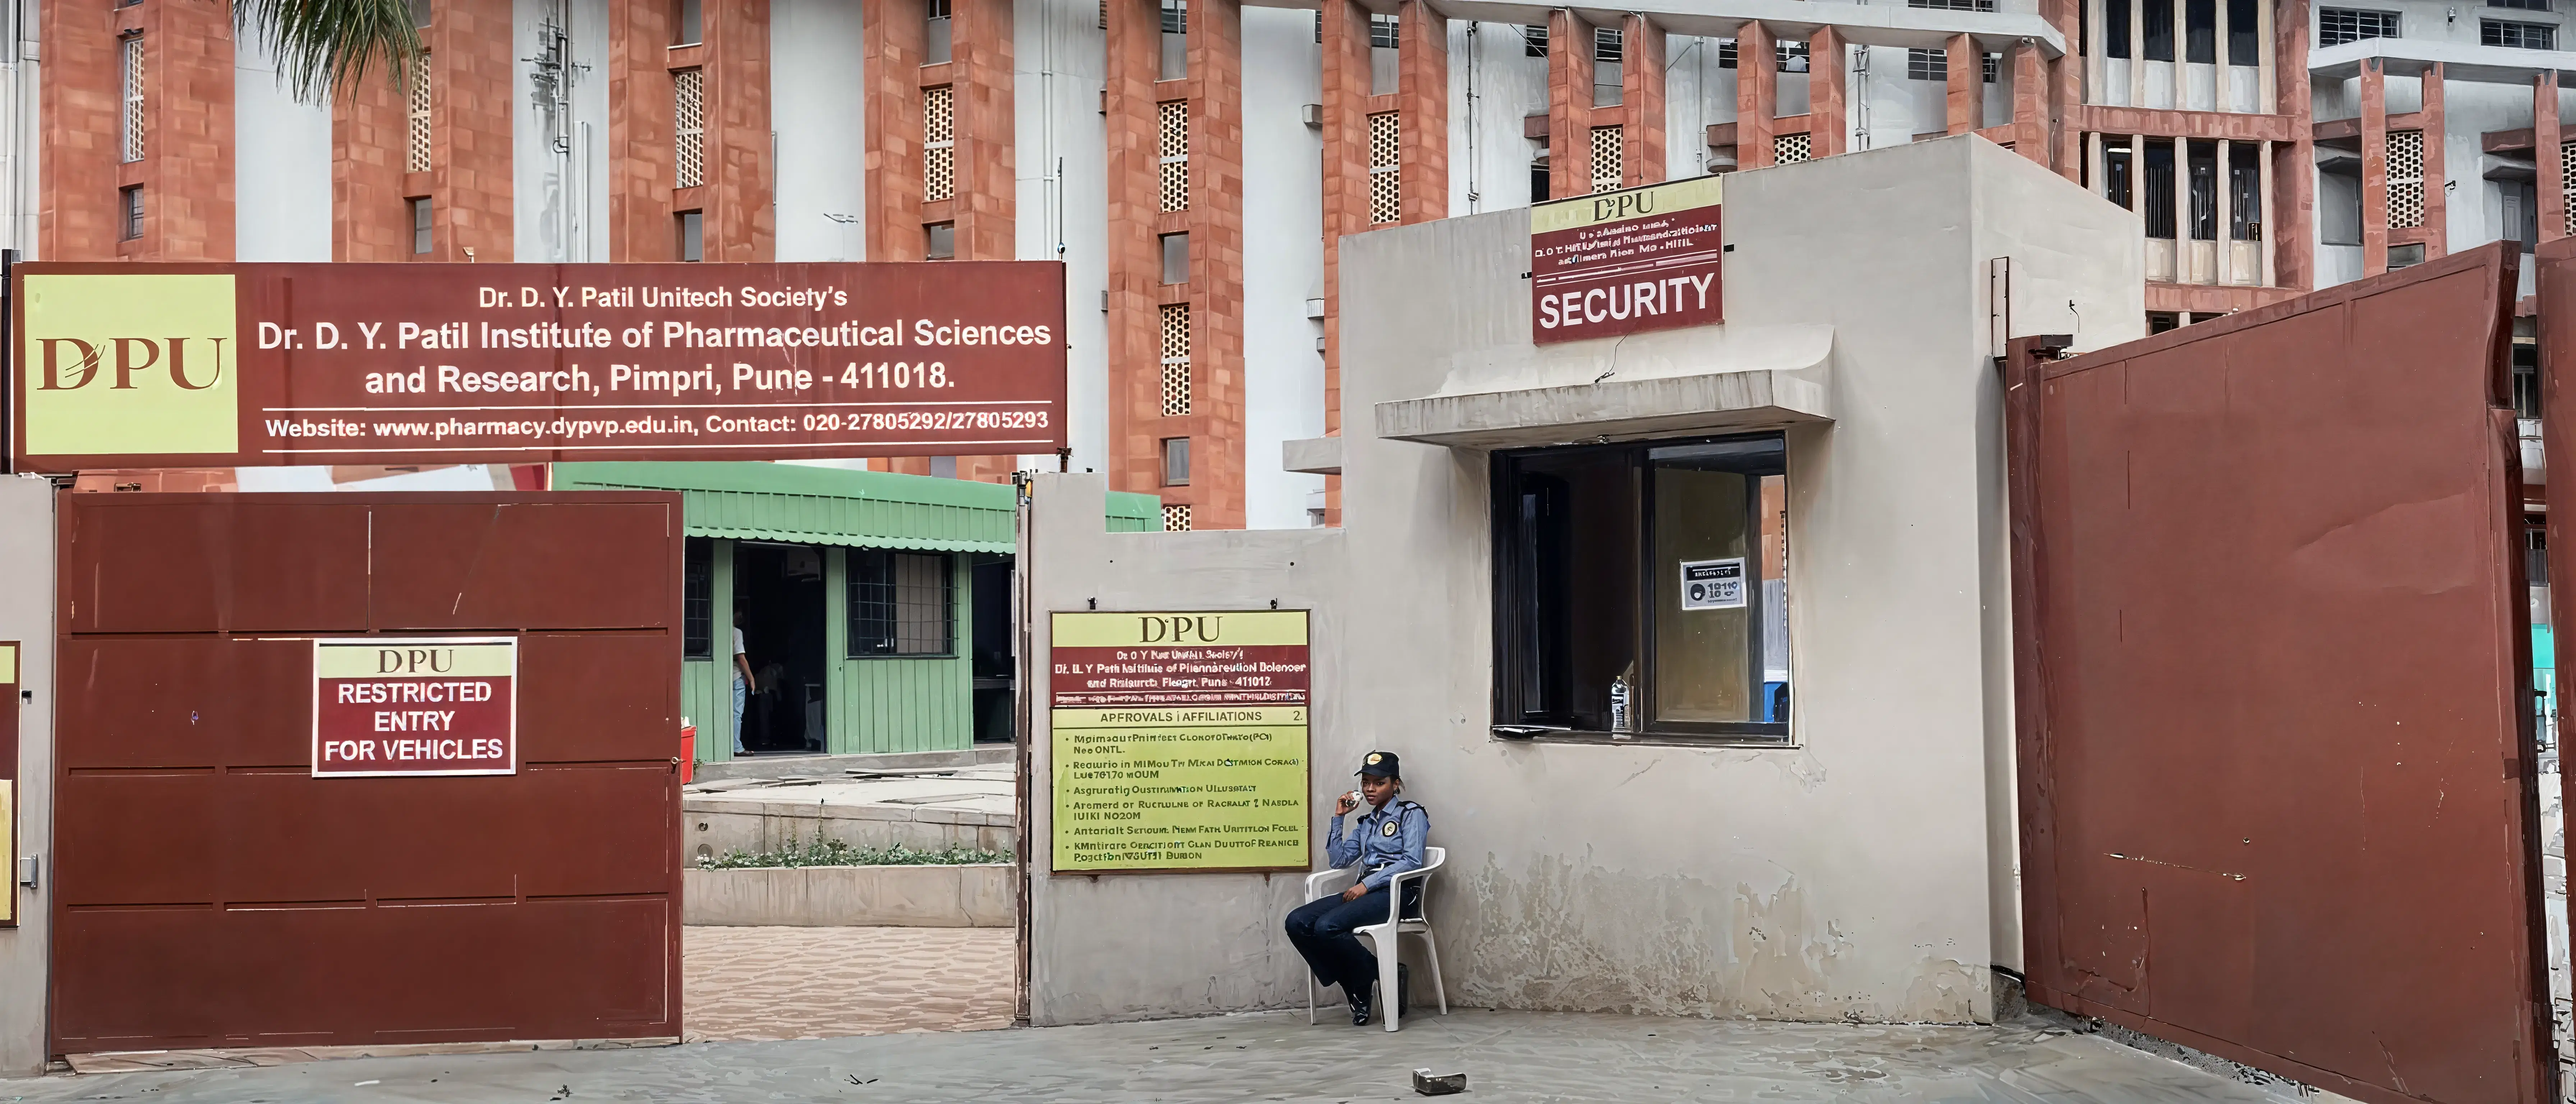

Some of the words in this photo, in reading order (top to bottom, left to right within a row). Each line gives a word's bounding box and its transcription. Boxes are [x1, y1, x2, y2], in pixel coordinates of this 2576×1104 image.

[1593, 191, 1655, 221] DPU
[480, 287, 512, 307] Dr.
[522, 287, 545, 307] D.
[552, 286, 574, 307] Y.
[582, 286, 634, 308] Patil
[642, 286, 732, 308] Unitech
[740, 286, 848, 311] Society's
[1539, 272, 1715, 329] SECURITY
[259, 322, 303, 350] Dr.
[316, 322, 348, 350] D.
[357, 322, 386, 349] Y.
[399, 322, 469, 349] Patil
[481, 321, 612, 349] Institute
[622, 321, 653, 348] of
[664, 319, 903, 348] Pharmaceutical
[915, 319, 1051, 346] Sciences
[36, 338, 227, 390] DPU
[365, 366, 425, 394] and
[438, 364, 599, 397] Research,
[611, 363, 722, 397] Pimpri,
[733, 363, 813, 391] Pune
[840, 362, 954, 389] 411018.
[265, 419, 366, 437] Website:
[373, 415, 699, 441] www.pharmacy.dypvp.edu.in,
[706, 415, 796, 433] Contact:
[804, 411, 1049, 431] 020-27805292/27805293
[1138, 616, 1223, 643] DPU
[377, 649, 454, 673] DPU
[338, 681, 492, 704] RESTRICTED
[374, 710, 455, 732] ENTRY
[1182, 711, 1262, 722] AFFILIATIONS
[325, 740, 376, 761] FOR
[383, 739, 503, 760] VEHICLES
